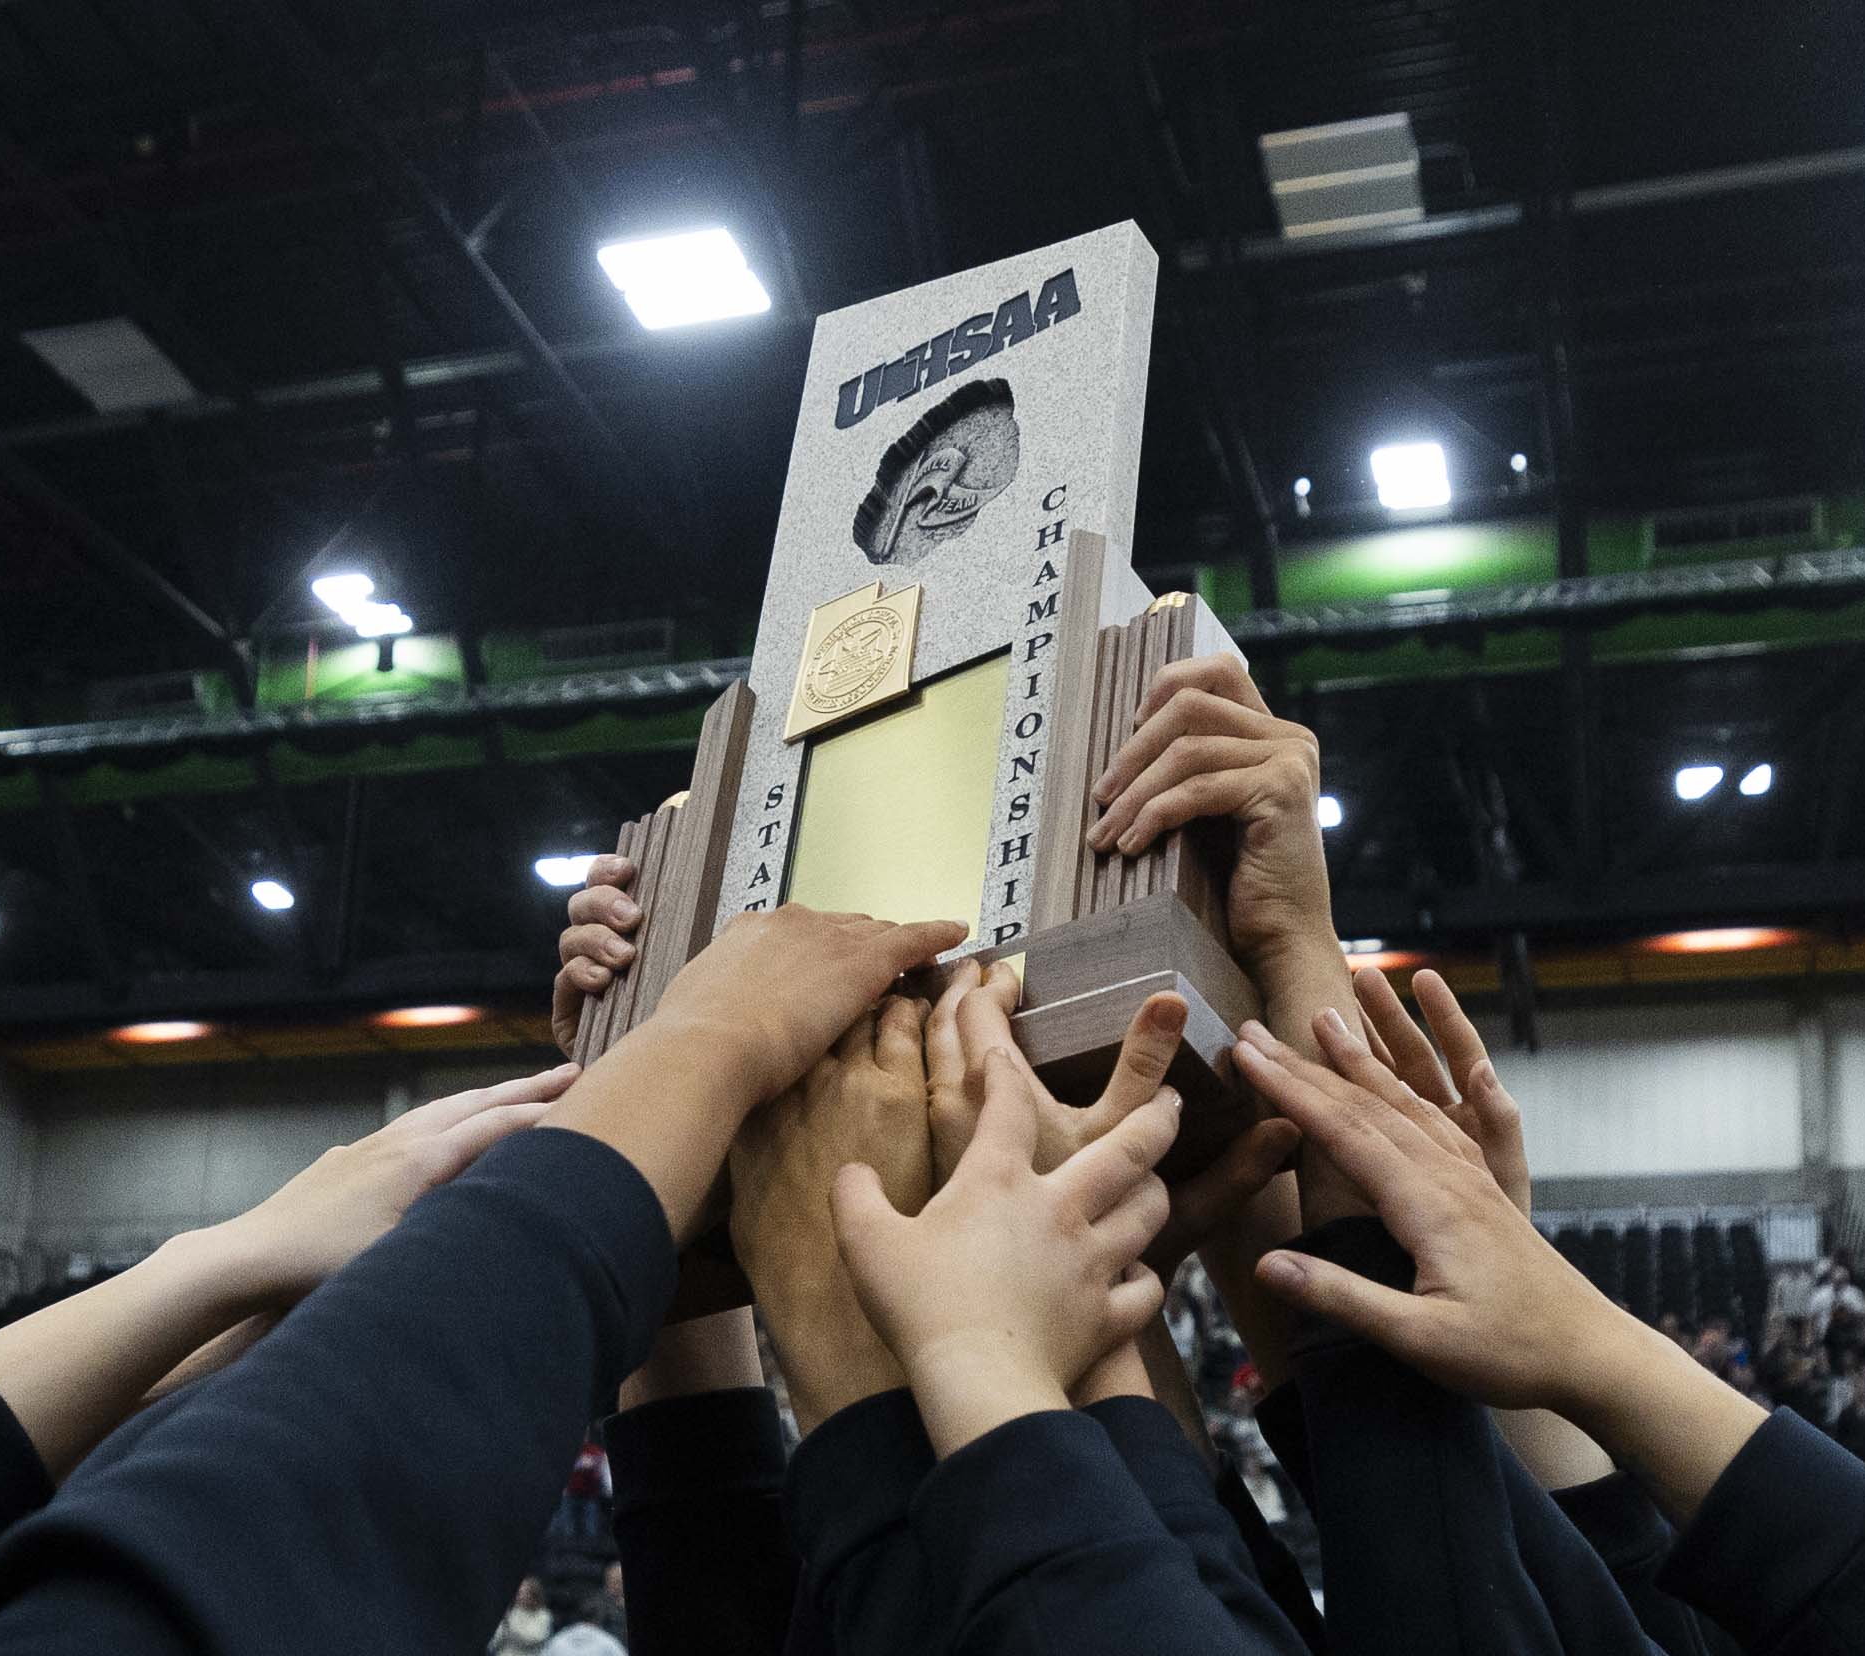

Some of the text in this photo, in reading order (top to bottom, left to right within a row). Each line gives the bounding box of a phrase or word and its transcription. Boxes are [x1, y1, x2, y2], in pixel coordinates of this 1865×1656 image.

[834, 267, 1082, 430] UHSAA
[937, 494, 977, 513] TEAM
[992, 484, 1068, 946] CHAMPIONSHIP
[744, 783, 785, 912] STAT
